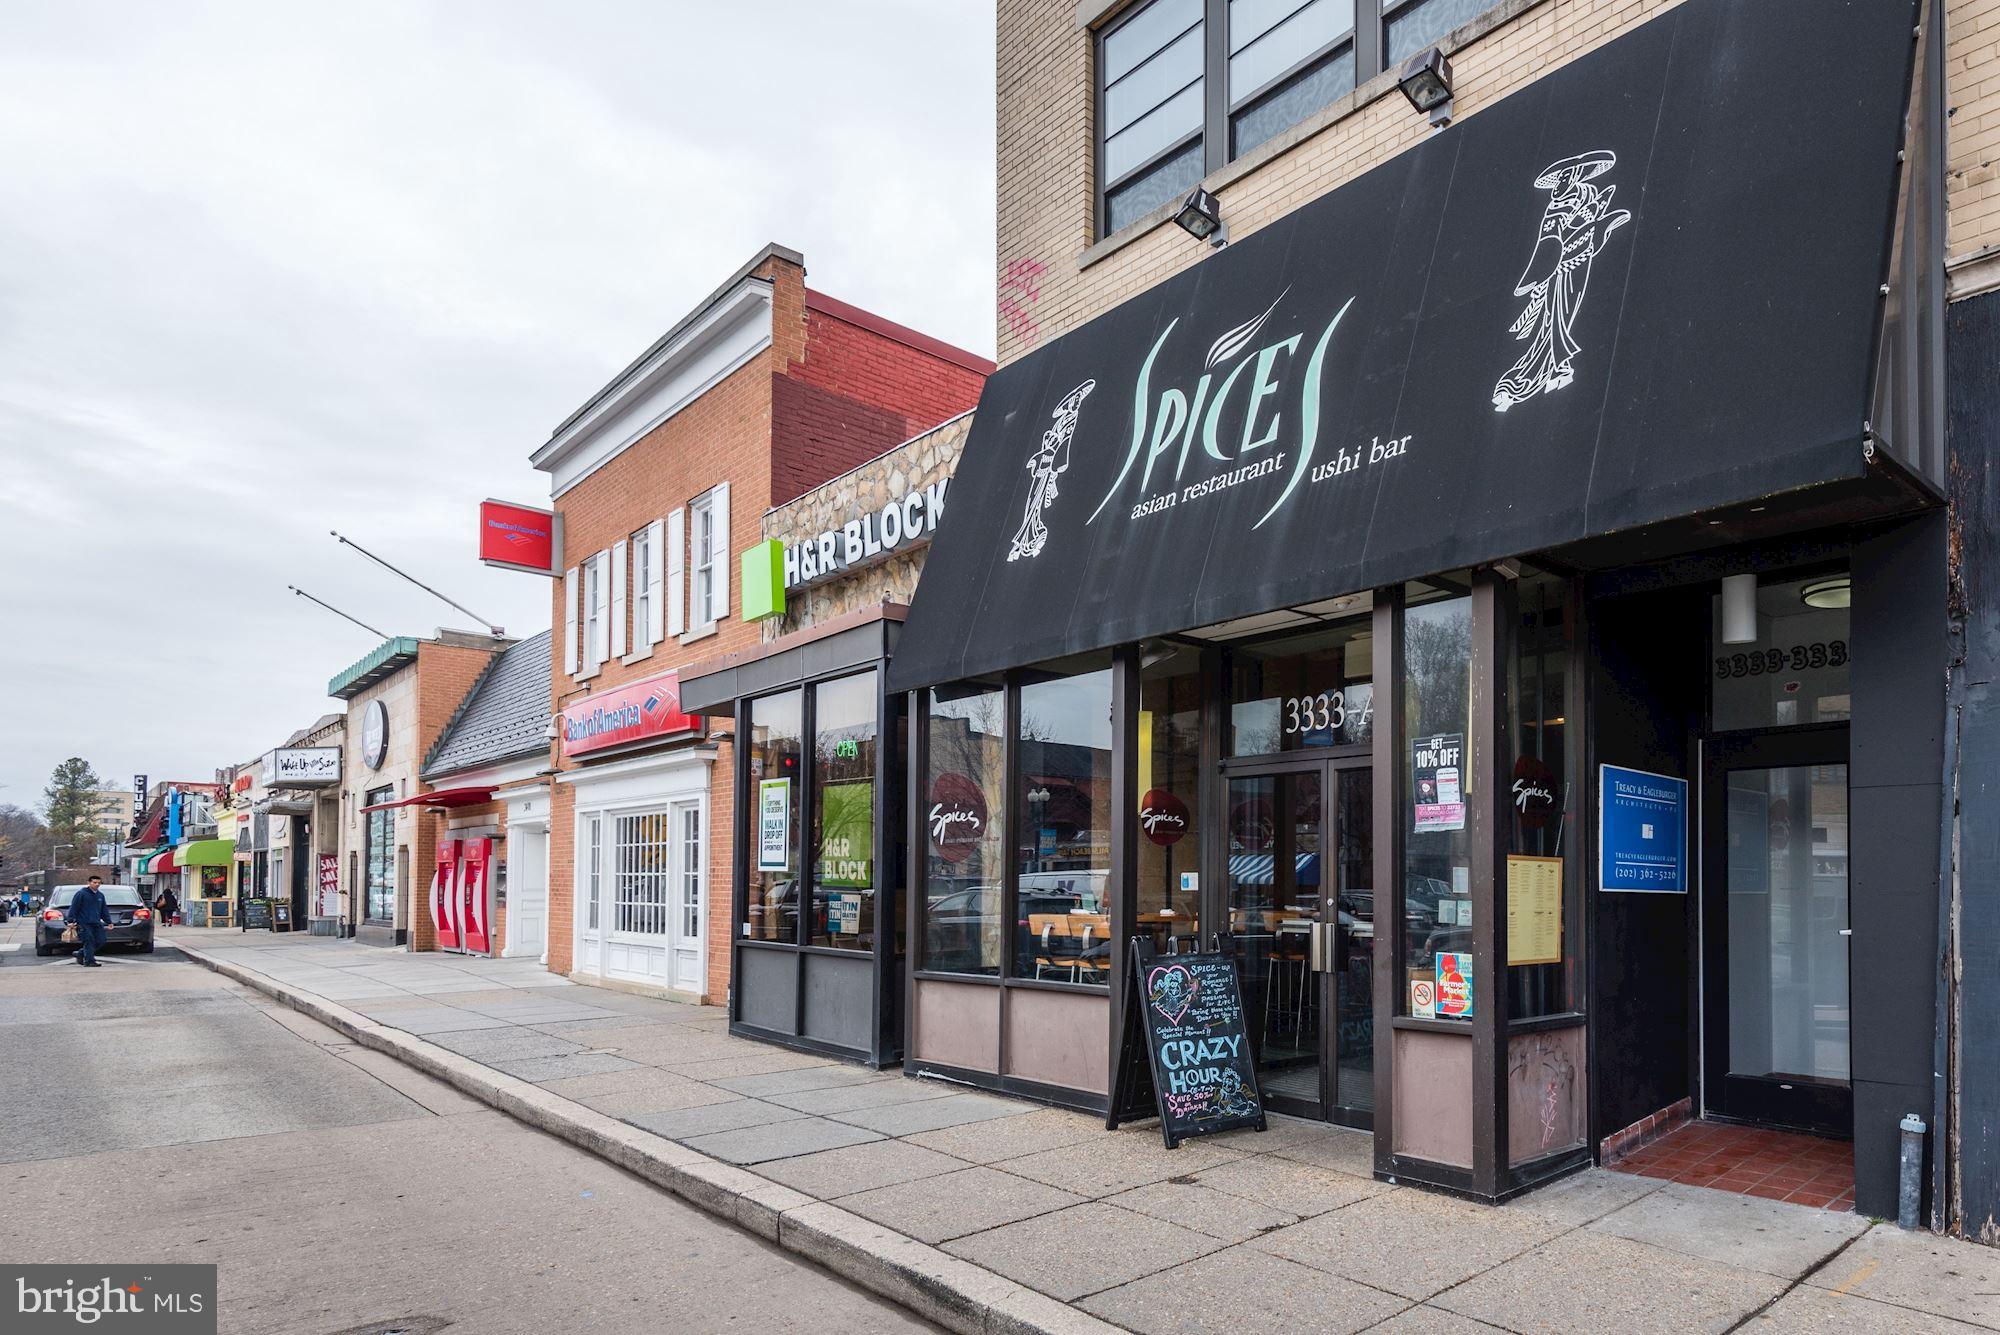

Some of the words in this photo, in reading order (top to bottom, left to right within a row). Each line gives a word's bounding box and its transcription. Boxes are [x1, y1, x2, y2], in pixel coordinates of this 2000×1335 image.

[1369, 434, 1412, 464] bar
[1130, 492, 1177, 520] asian
[1181, 451, 1286, 503] restaurant
[784, 531, 838, 589] H&R
[844, 477, 949, 565] BLOCK
[1715, 640, 1850, 679] 3333-333
[1286, 685, 1373, 734] 3333-A
[837, 740, 858, 757] OPEN
[1431, 738, 1443, 750] GET
[1416, 749, 1438, 768] 10%
[1440, 747, 1459, 766] OFF
[134, 775, 145, 810] CLUB
[1512, 778, 1553, 813] Spices
[1615, 781, 1636, 793] TREACY
[1637, 787, 1642, 795] &
[1643, 785, 1677, 800] EAGLEBURGER
[1615, 799, 1662, 811] ARCHITECTS
[764, 819, 777, 829] WALK
[778, 819, 784, 829] IN
[929, 803, 980, 845] Spices
[1140, 807, 1184, 835] Spices
[764, 831, 775, 840] DROP
[775, 830, 783, 839] OFF
[825, 838, 850, 857] H&R
[320, 858, 338, 870] SAL
[824, 860, 867, 881] BLOCK
[1615, 867, 1637, 879] (202)
[1640, 867, 1676, 880] 362-5226
[320, 872, 338, 883] SAL
[320, 883, 338, 894] SAL
[829, 900, 841, 909] FREE
[842, 901, 858, 912] ITIN
[1161, 1034, 1241, 1070] CRAZY
[1168, 1067, 1223, 1095] HOUR
